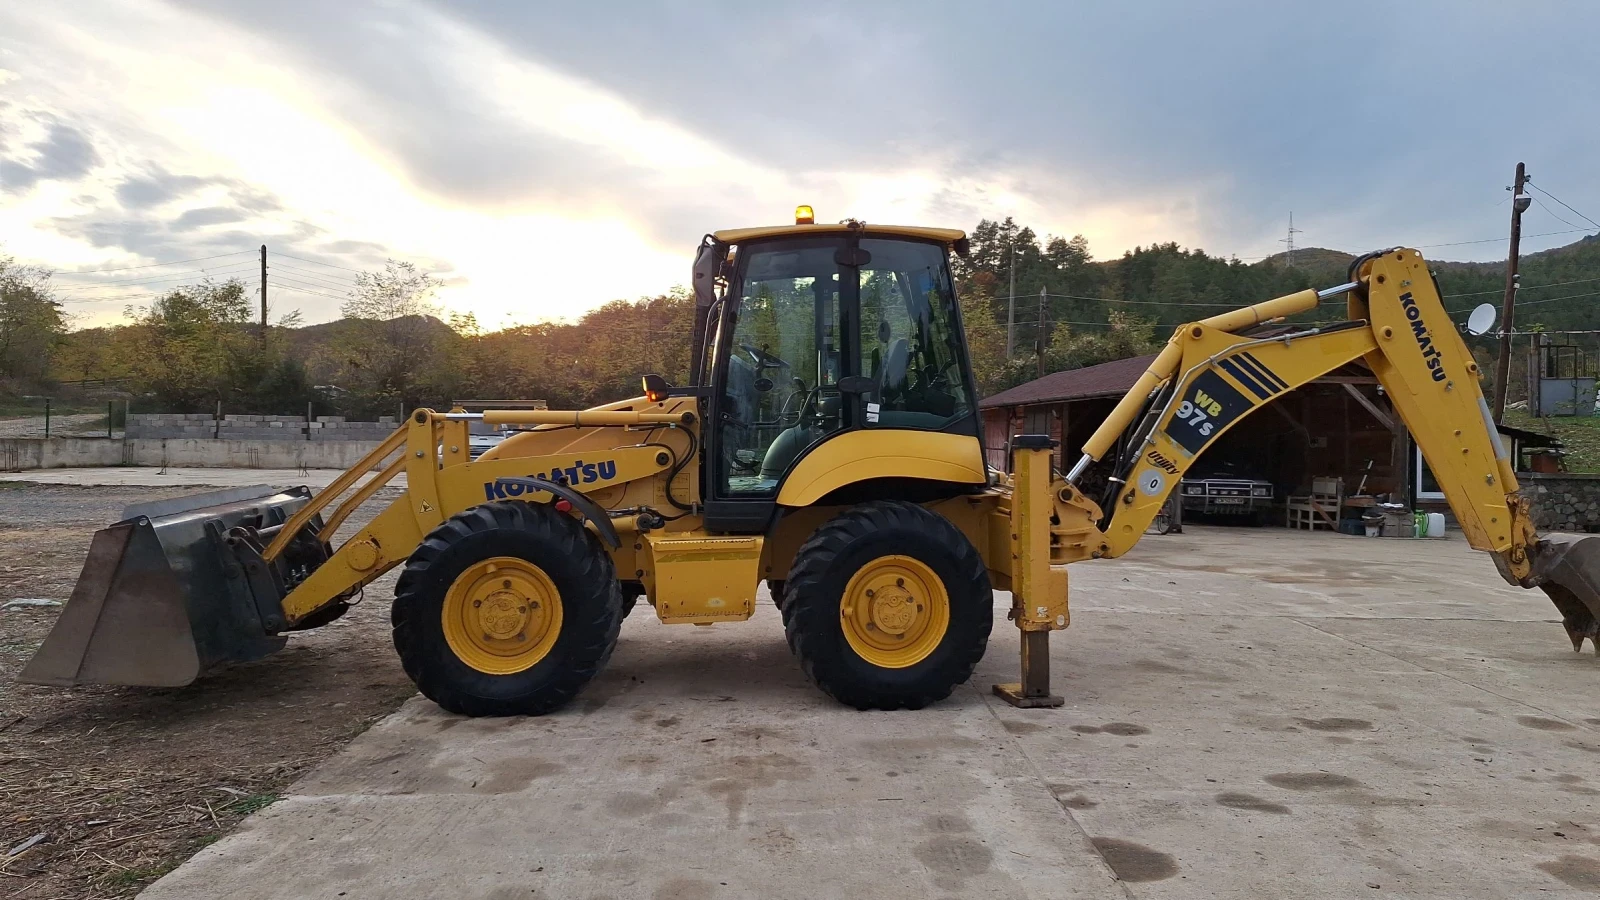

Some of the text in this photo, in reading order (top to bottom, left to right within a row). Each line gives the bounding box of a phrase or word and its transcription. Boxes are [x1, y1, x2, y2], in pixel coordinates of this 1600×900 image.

[1399, 291, 1446, 382] KOMATSU
[1194, 389, 1222, 417] WB
[1147, 450, 1180, 475] Utility
